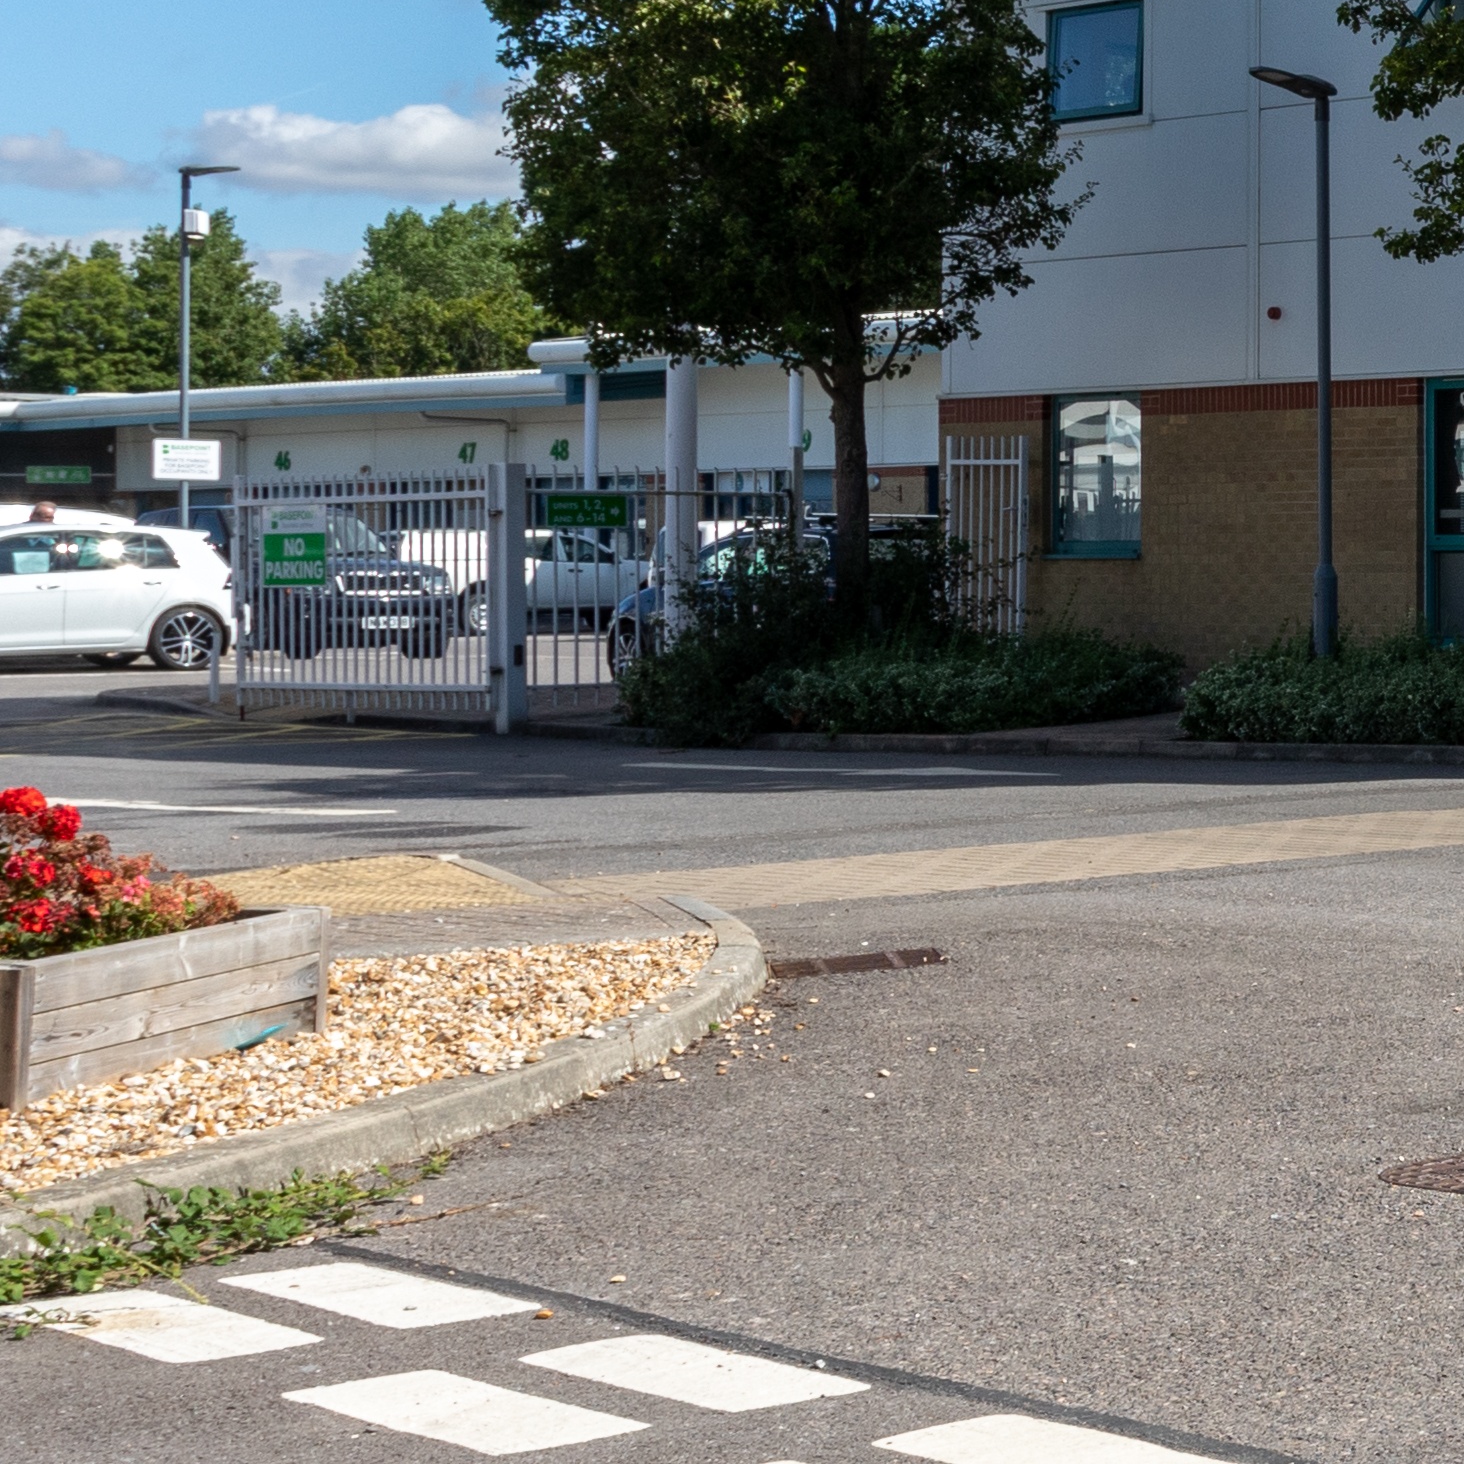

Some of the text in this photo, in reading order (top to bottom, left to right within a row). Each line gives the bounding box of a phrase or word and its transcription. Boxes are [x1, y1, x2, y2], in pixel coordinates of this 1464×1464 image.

[458, 442, 477, 464] 47
[550, 438, 570, 461] 48
[274, 450, 291, 471] 46
[553, 515, 573, 523] AND
[283, 538, 305, 556] NO
[265, 560, 324, 579] PARKING
